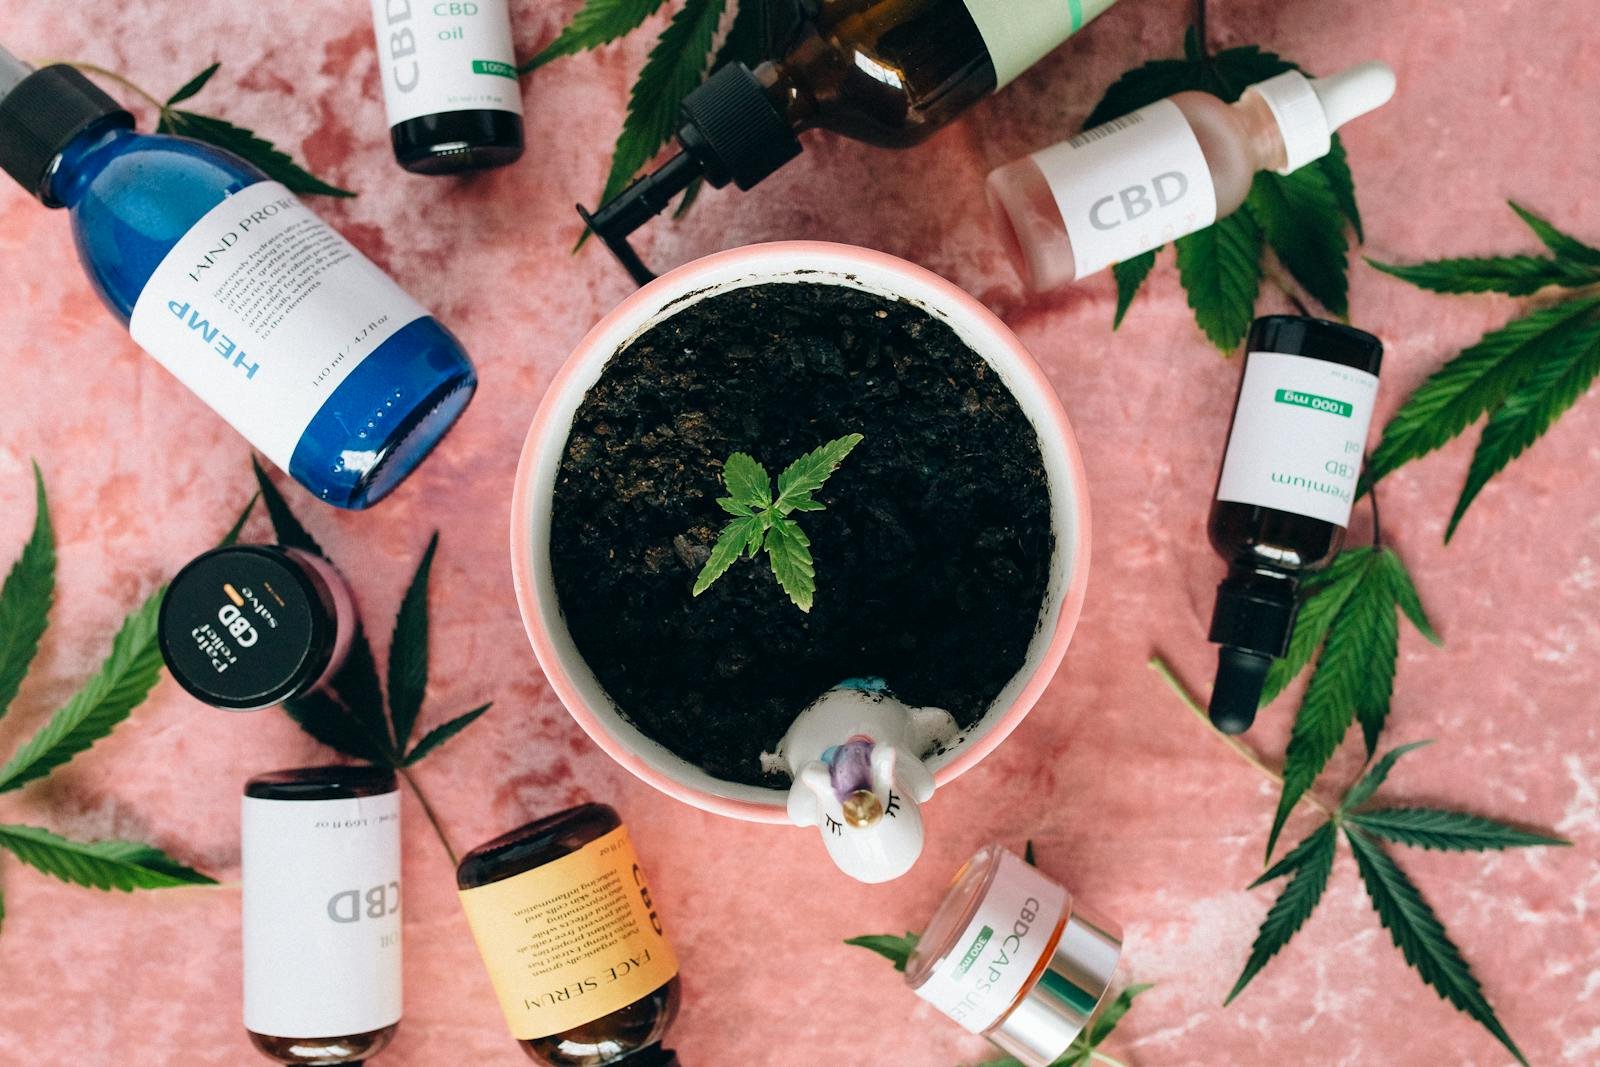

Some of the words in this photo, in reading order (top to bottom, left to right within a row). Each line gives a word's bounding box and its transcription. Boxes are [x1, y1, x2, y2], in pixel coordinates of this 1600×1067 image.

[434, 3, 478, 16] CBD
[386, 0, 419, 93] CBD
[439, 27, 463, 40] oil
[1088, 171, 1189, 231] CBD
[246, 248, 277, 275] making
[236, 278, 256, 299] hard
[292, 274, 314, 294] when
[240, 295, 265, 322] cream
[265, 274, 287, 296] gives
[247, 310, 263, 328] and
[262, 288, 283, 311] relief
[283, 277, 297, 289] for
[270, 313, 285, 329] the
[285, 280, 321, 314] elements
[167, 300, 260, 380] HEMP
[332, 352, 345, 368] ml
[353, 329, 369, 344] 4.7
[1283, 390, 1309, 405] mg
[1311, 397, 1345, 415] 1000
[1344, 440, 1360, 454] oil
[1270, 472, 1352, 503] Premium
[241, 588, 279, 628] salve
[218, 604, 259, 648] CBD
[190, 628, 228, 674] Pain
[198, 624, 237, 664] relief
[580, 868, 618, 890] reducing
[327, 882, 400, 923] CBD
[545, 902, 568, 916] cells
[546, 893, 608, 925] rejuvenating
[570, 893, 590, 905] skin
[632, 863, 663, 937] CBD
[524, 912, 544, 923] and
[559, 911, 594, 930] effects
[577, 910, 614, 932] prevent
[531, 926, 558, 941] while
[532, 933, 584, 959] properties
[554, 928, 576, 942] free
[583, 932, 613, 949] Hemp
[546, 946, 582, 964] Extract
[566, 938, 619, 966] organically
[969, 936, 988, 958] 300
[532, 961, 563, 977] grown
[605, 948, 652, 983] FACE
[523, 976, 598, 1010] SERUM
